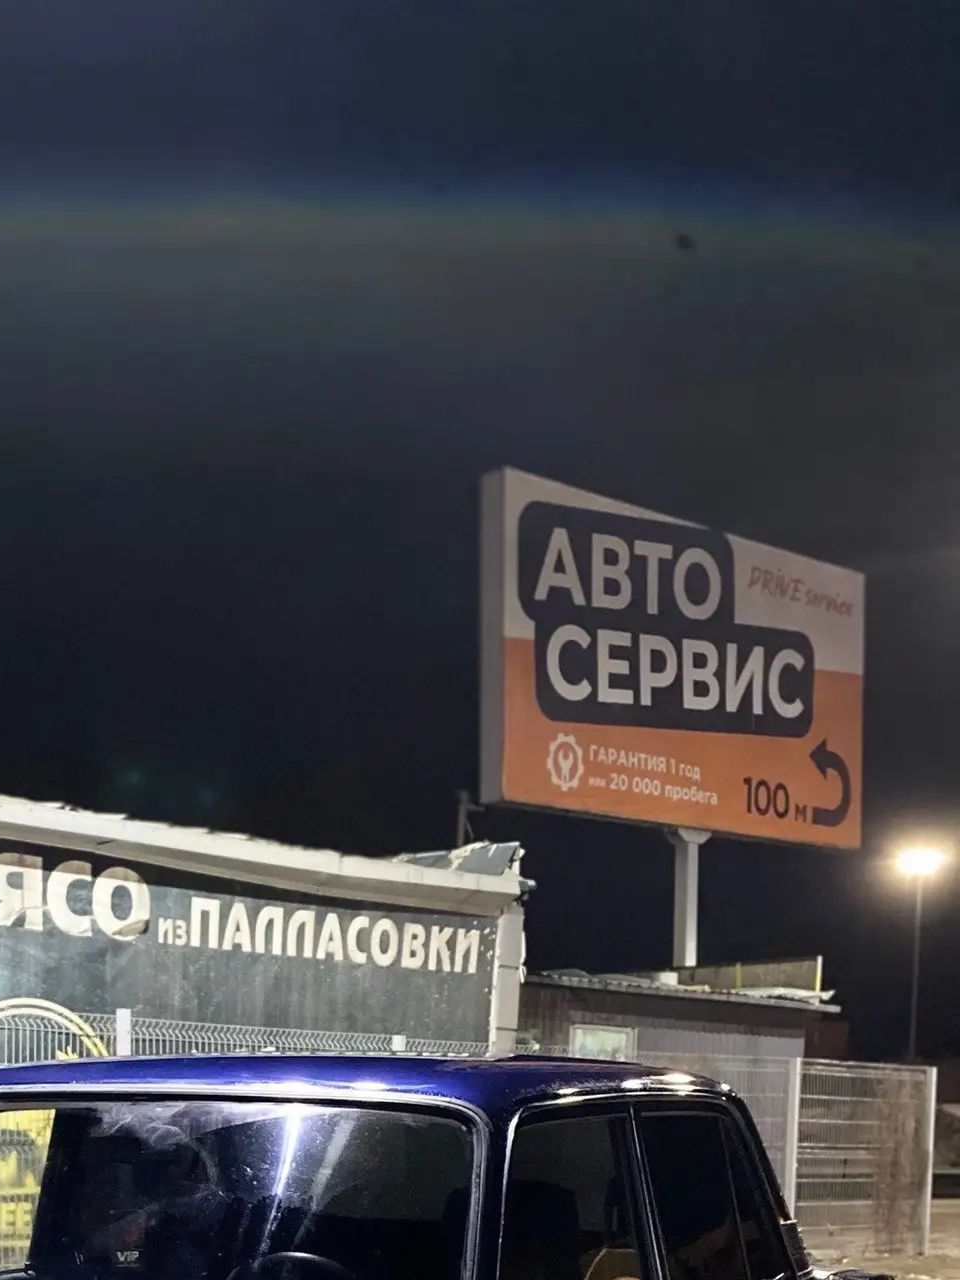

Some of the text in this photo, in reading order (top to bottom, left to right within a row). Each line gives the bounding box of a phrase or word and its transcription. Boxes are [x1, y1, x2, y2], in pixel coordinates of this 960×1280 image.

[534, 526, 722, 620] АВТО
[546, 624, 806, 718] СЕРВИС
[589, 744, 702, 782] ГАРАНТИЯ 1 год
[589, 773, 719, 806] или 20 000 пробега
[743, 777, 790, 819] 100
[157, 916, 188, 947] из
[190, 896, 481, 975] ПАЛЛАСОВКИ
